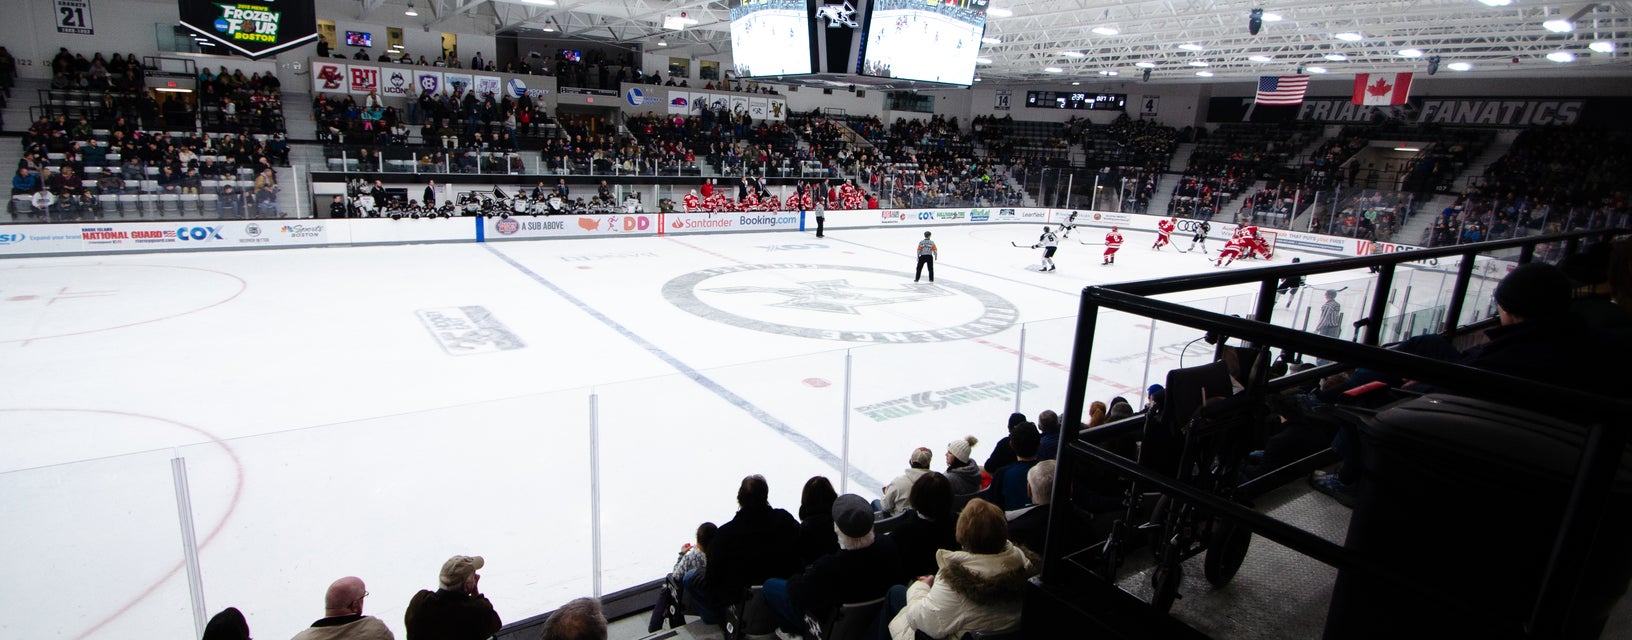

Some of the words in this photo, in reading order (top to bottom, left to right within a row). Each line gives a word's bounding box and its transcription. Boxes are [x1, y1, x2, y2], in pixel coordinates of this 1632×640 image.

[60, 7, 86, 27] 21
[220, 5, 279, 22] FROZEN
[235, 32, 275, 42] BOSTON
[384, 86, 407, 94] UCON
[1146, 99, 1154, 111] 4
[1297, 101, 1372, 121] FRIAR
[1416, 100, 1582, 125] FANATICS
[740, 215, 797, 226] Booking.com
[918, 211, 935, 220] COX
[521, 222, 527, 230] A
[528, 221, 542, 230] SUB
[543, 221, 564, 230] ABOVE
[685, 218, 733, 228] Santander
[82, 231, 129, 240] NATIONAL
[131, 230, 162, 239] GUARD
[177, 226, 224, 241] COX
